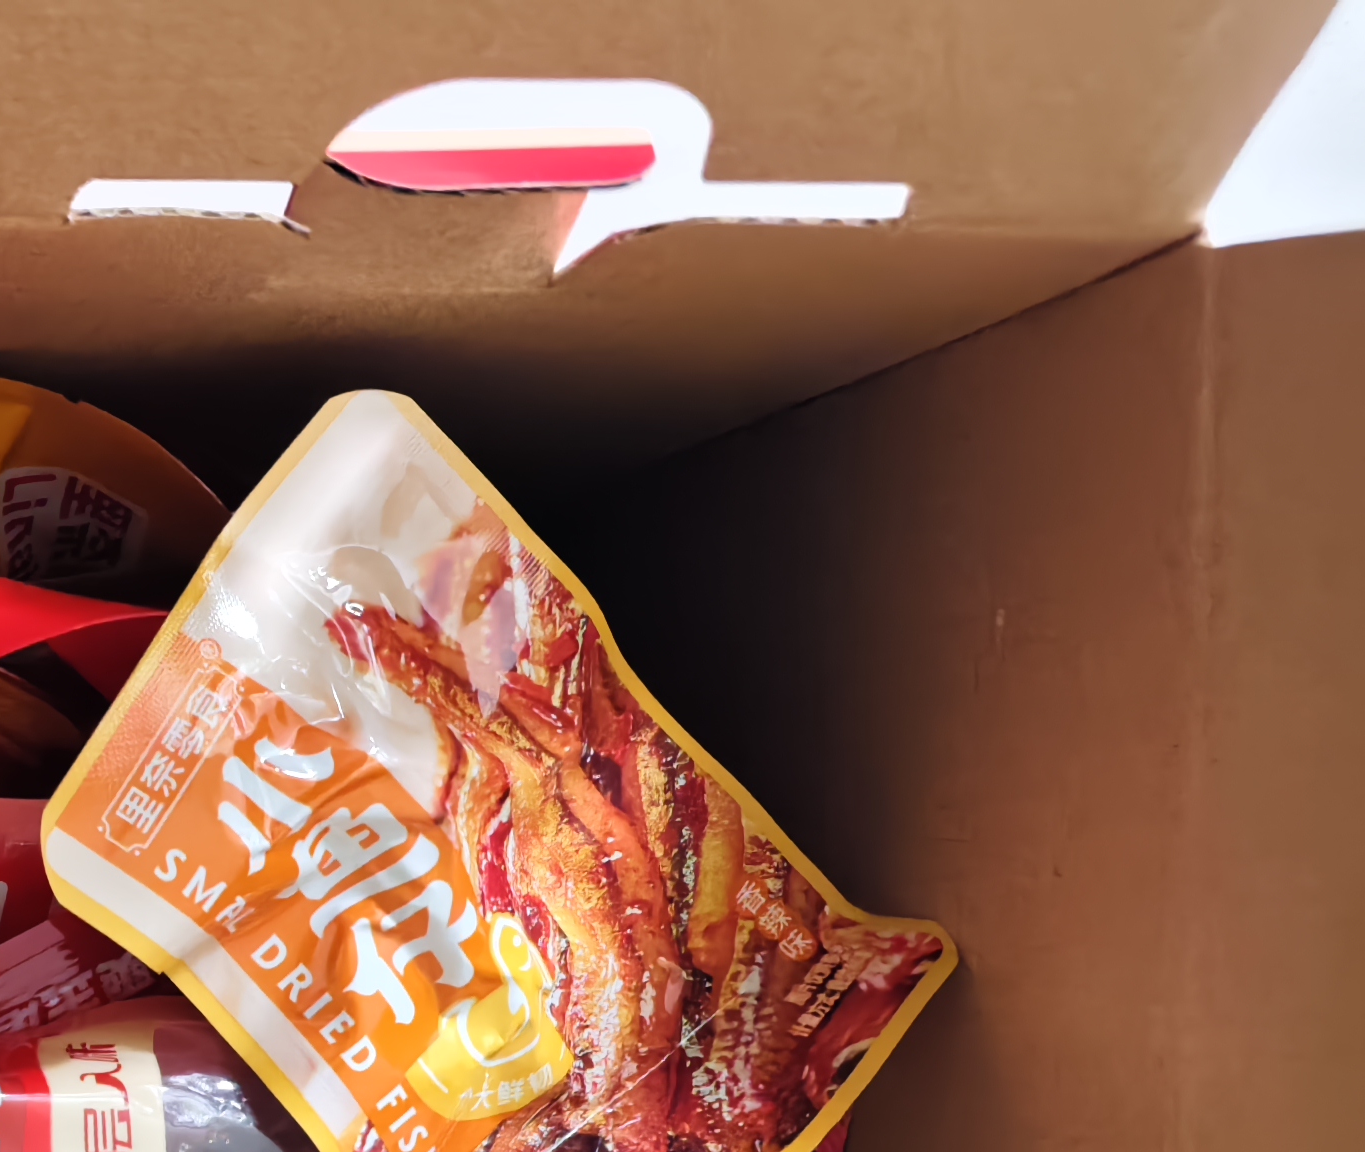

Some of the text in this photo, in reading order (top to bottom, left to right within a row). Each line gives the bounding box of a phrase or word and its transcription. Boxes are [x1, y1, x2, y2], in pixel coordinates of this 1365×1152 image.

[115, 685, 239, 836] 里奈零食
[736, 880, 814, 960] 香辣味
[251, 937, 378, 1073] DRIED
